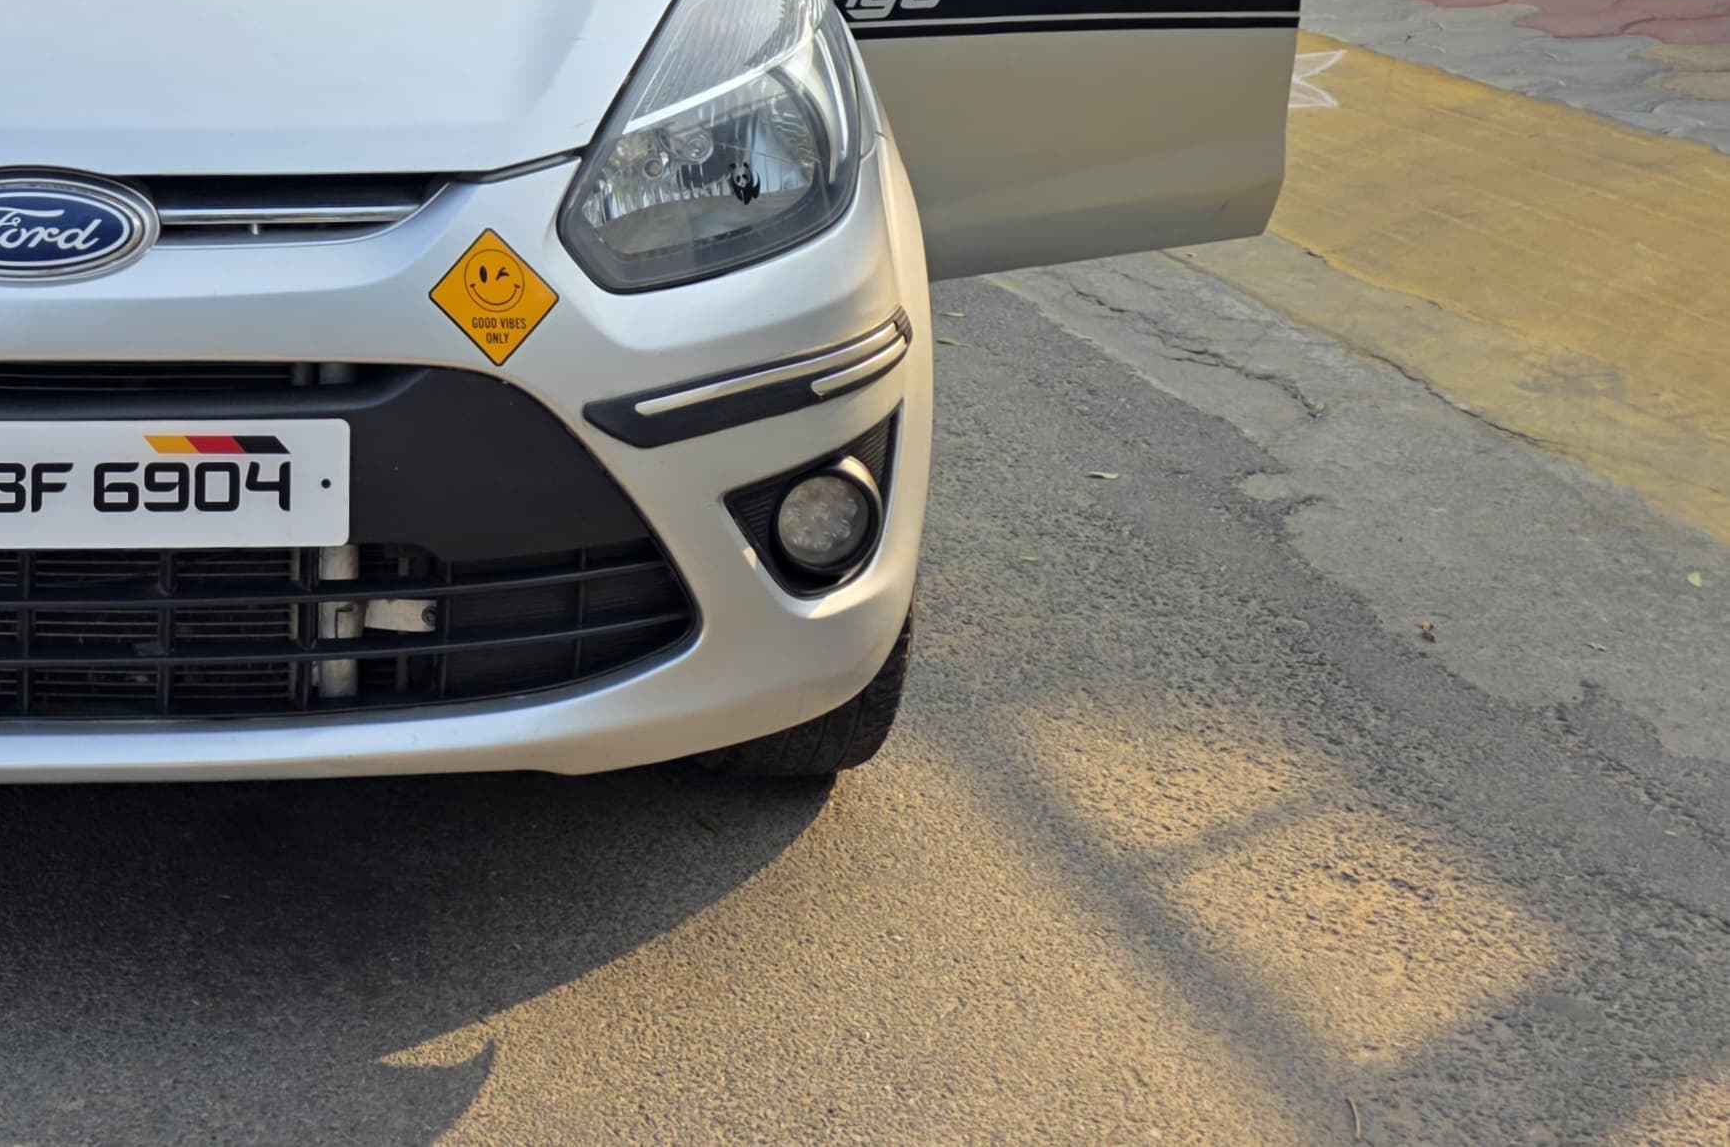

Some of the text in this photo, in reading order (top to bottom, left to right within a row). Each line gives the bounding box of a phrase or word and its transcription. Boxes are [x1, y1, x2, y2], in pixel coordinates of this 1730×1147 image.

[471, 316, 527, 330] GOOD VIBES
[486, 332, 510, 344] ONLY
[93, 461, 291, 513] 6904
